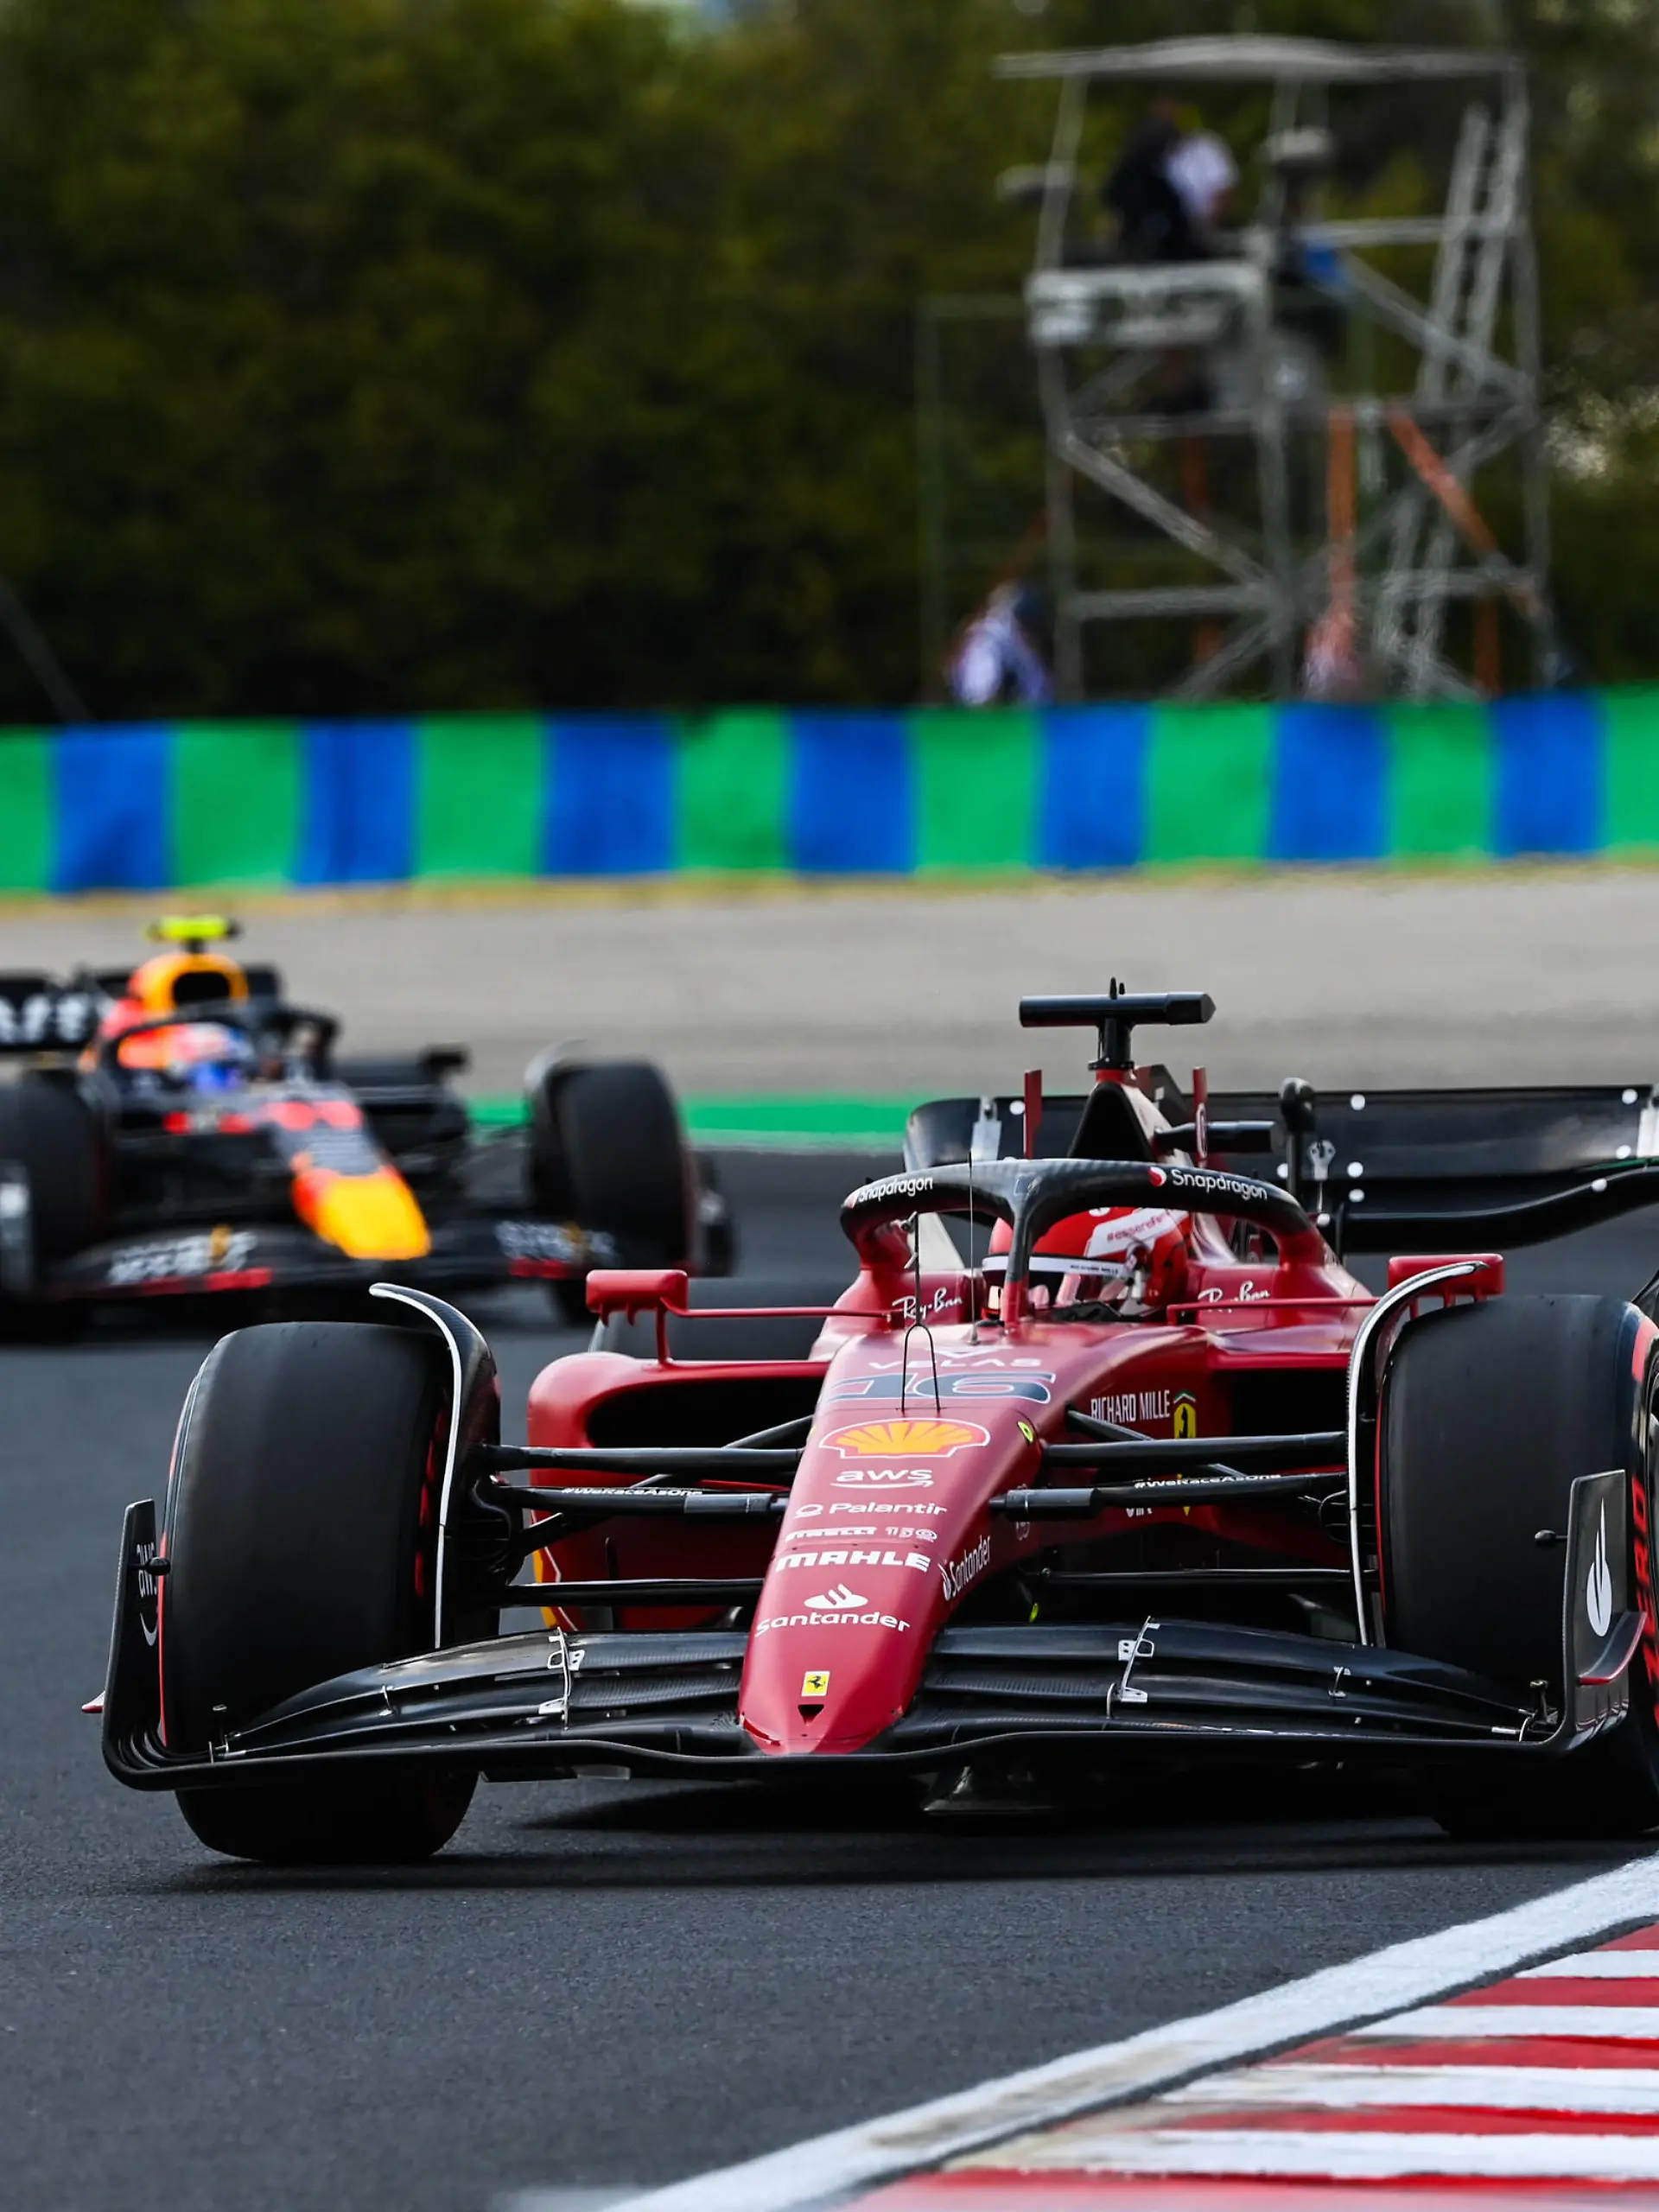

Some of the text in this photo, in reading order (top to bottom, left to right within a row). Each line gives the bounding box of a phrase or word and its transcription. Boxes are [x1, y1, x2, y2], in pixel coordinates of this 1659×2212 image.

[1171, 1168, 1268, 1201] Snapdragon
[868, 1358, 1041, 1370] VELAS
[830, 1371, 1056, 1404] 16
[1090, 1389, 1171, 1424] RICHARD MILLE
[836, 1469, 932, 1482] aws
[1134, 1474, 1281, 1490] #WeRaceAsOne
[830, 1502, 948, 1516] Palantir
[776, 1551, 931, 1573] MAHLE
[950, 1535, 991, 1598] Santander
[754, 1611, 911, 1637] Santander
